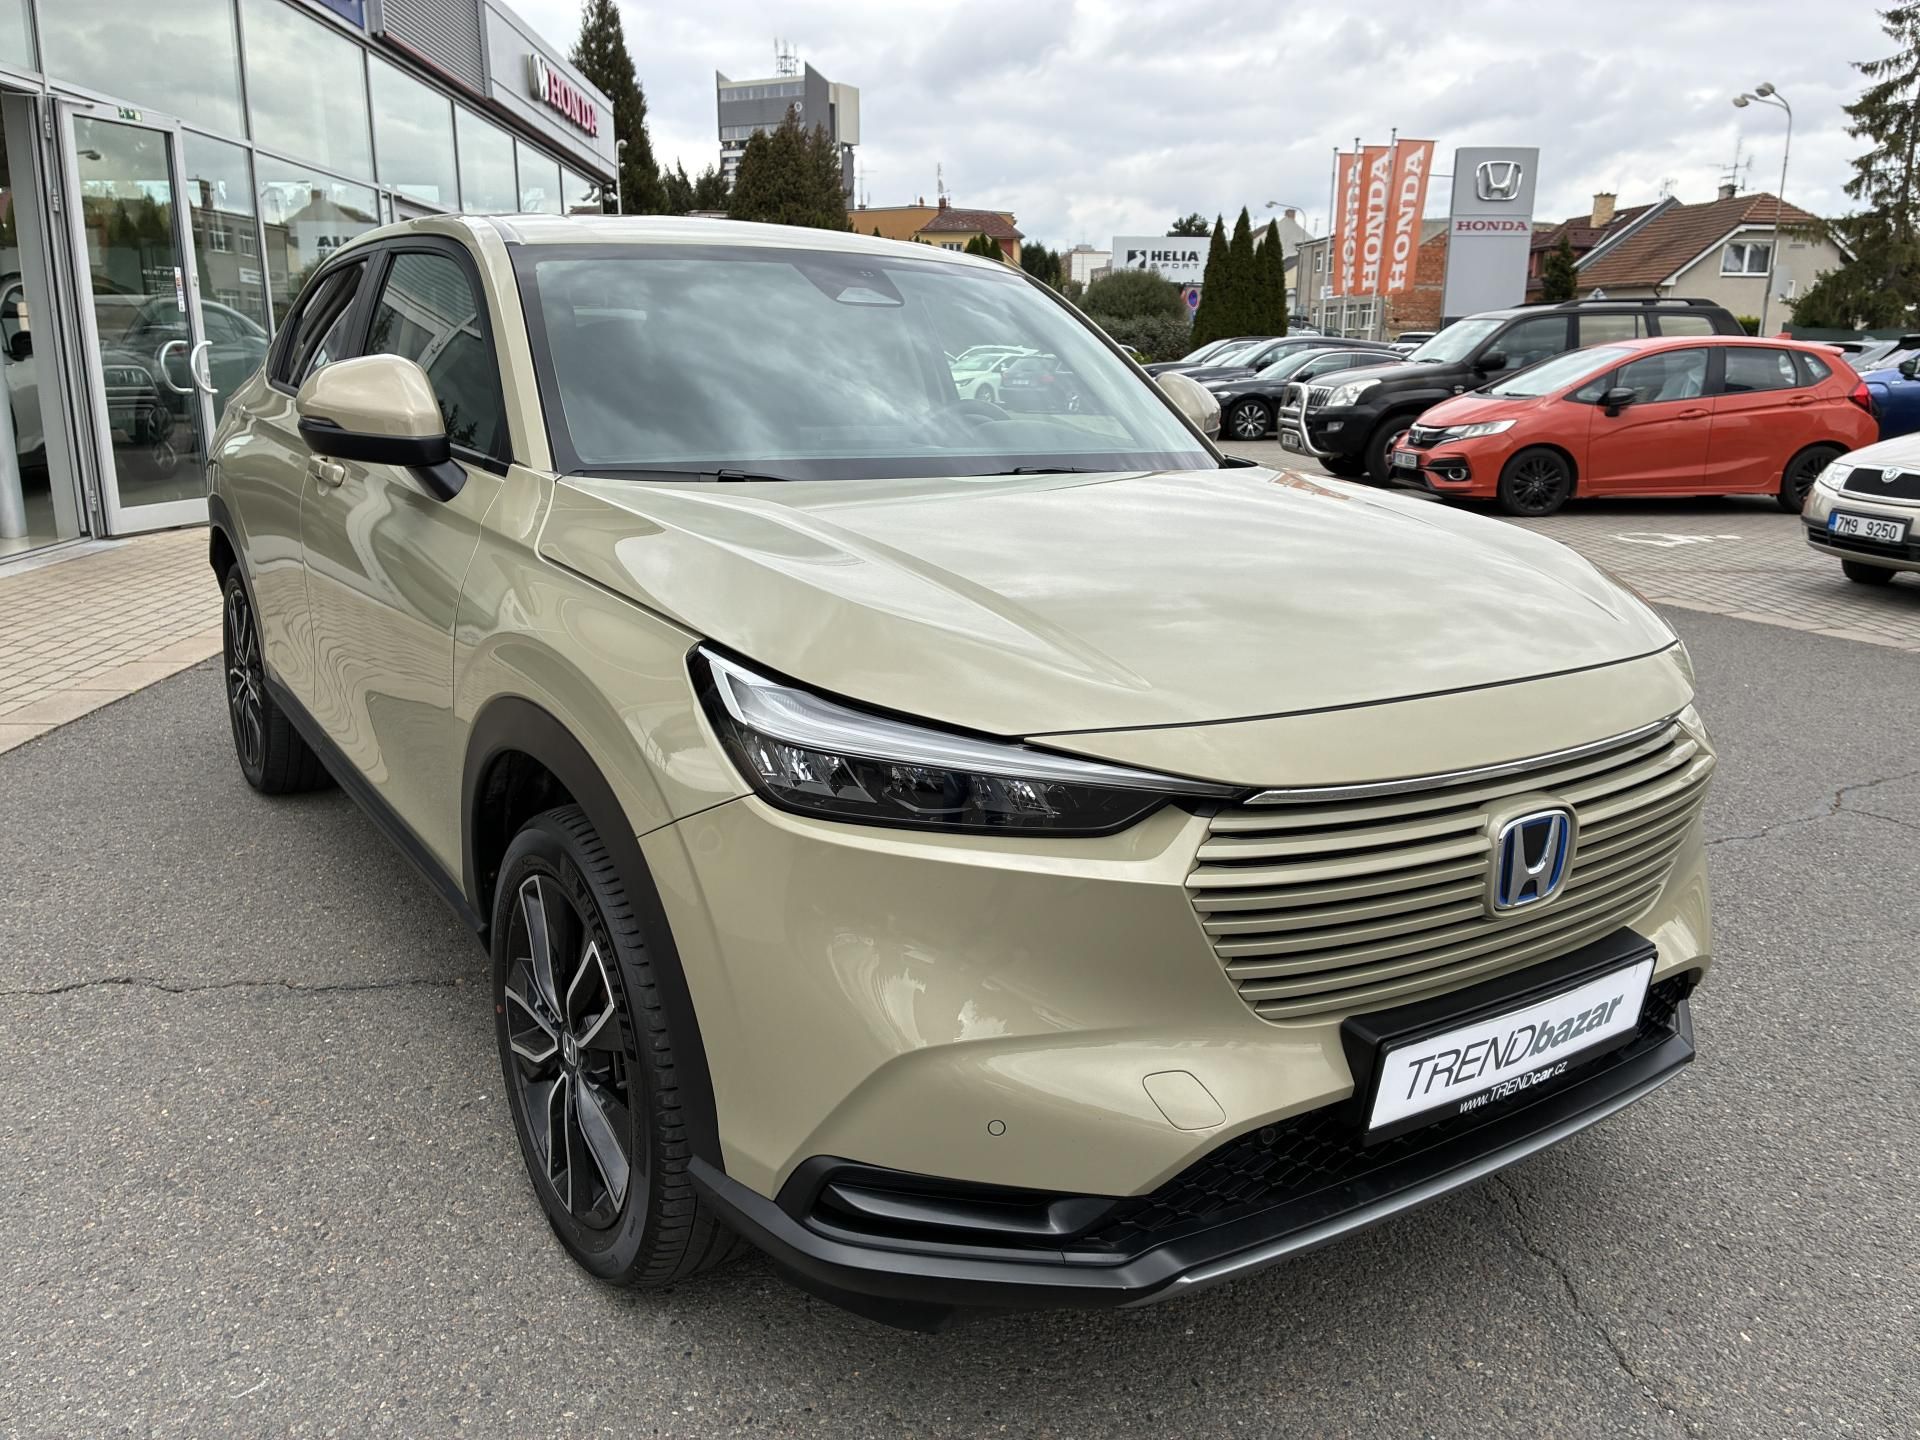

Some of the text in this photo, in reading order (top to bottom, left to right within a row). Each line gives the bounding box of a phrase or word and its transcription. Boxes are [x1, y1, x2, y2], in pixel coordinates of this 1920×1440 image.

[547, 69, 599, 136] HONDA
[1362, 150, 1390, 291] HONDA
[1388, 145, 1425, 291] HONDA
[1455, 220, 1528, 232] HONDA
[1150, 262, 1200, 270] SPORT
[1151, 250, 1199, 262] HELIA
[1837, 516, 1898, 540] 7M9 9250
[1406, 994, 1625, 1100] TRENDbazar
[1459, 1061, 1569, 1113] www.TRENDcar.cz
